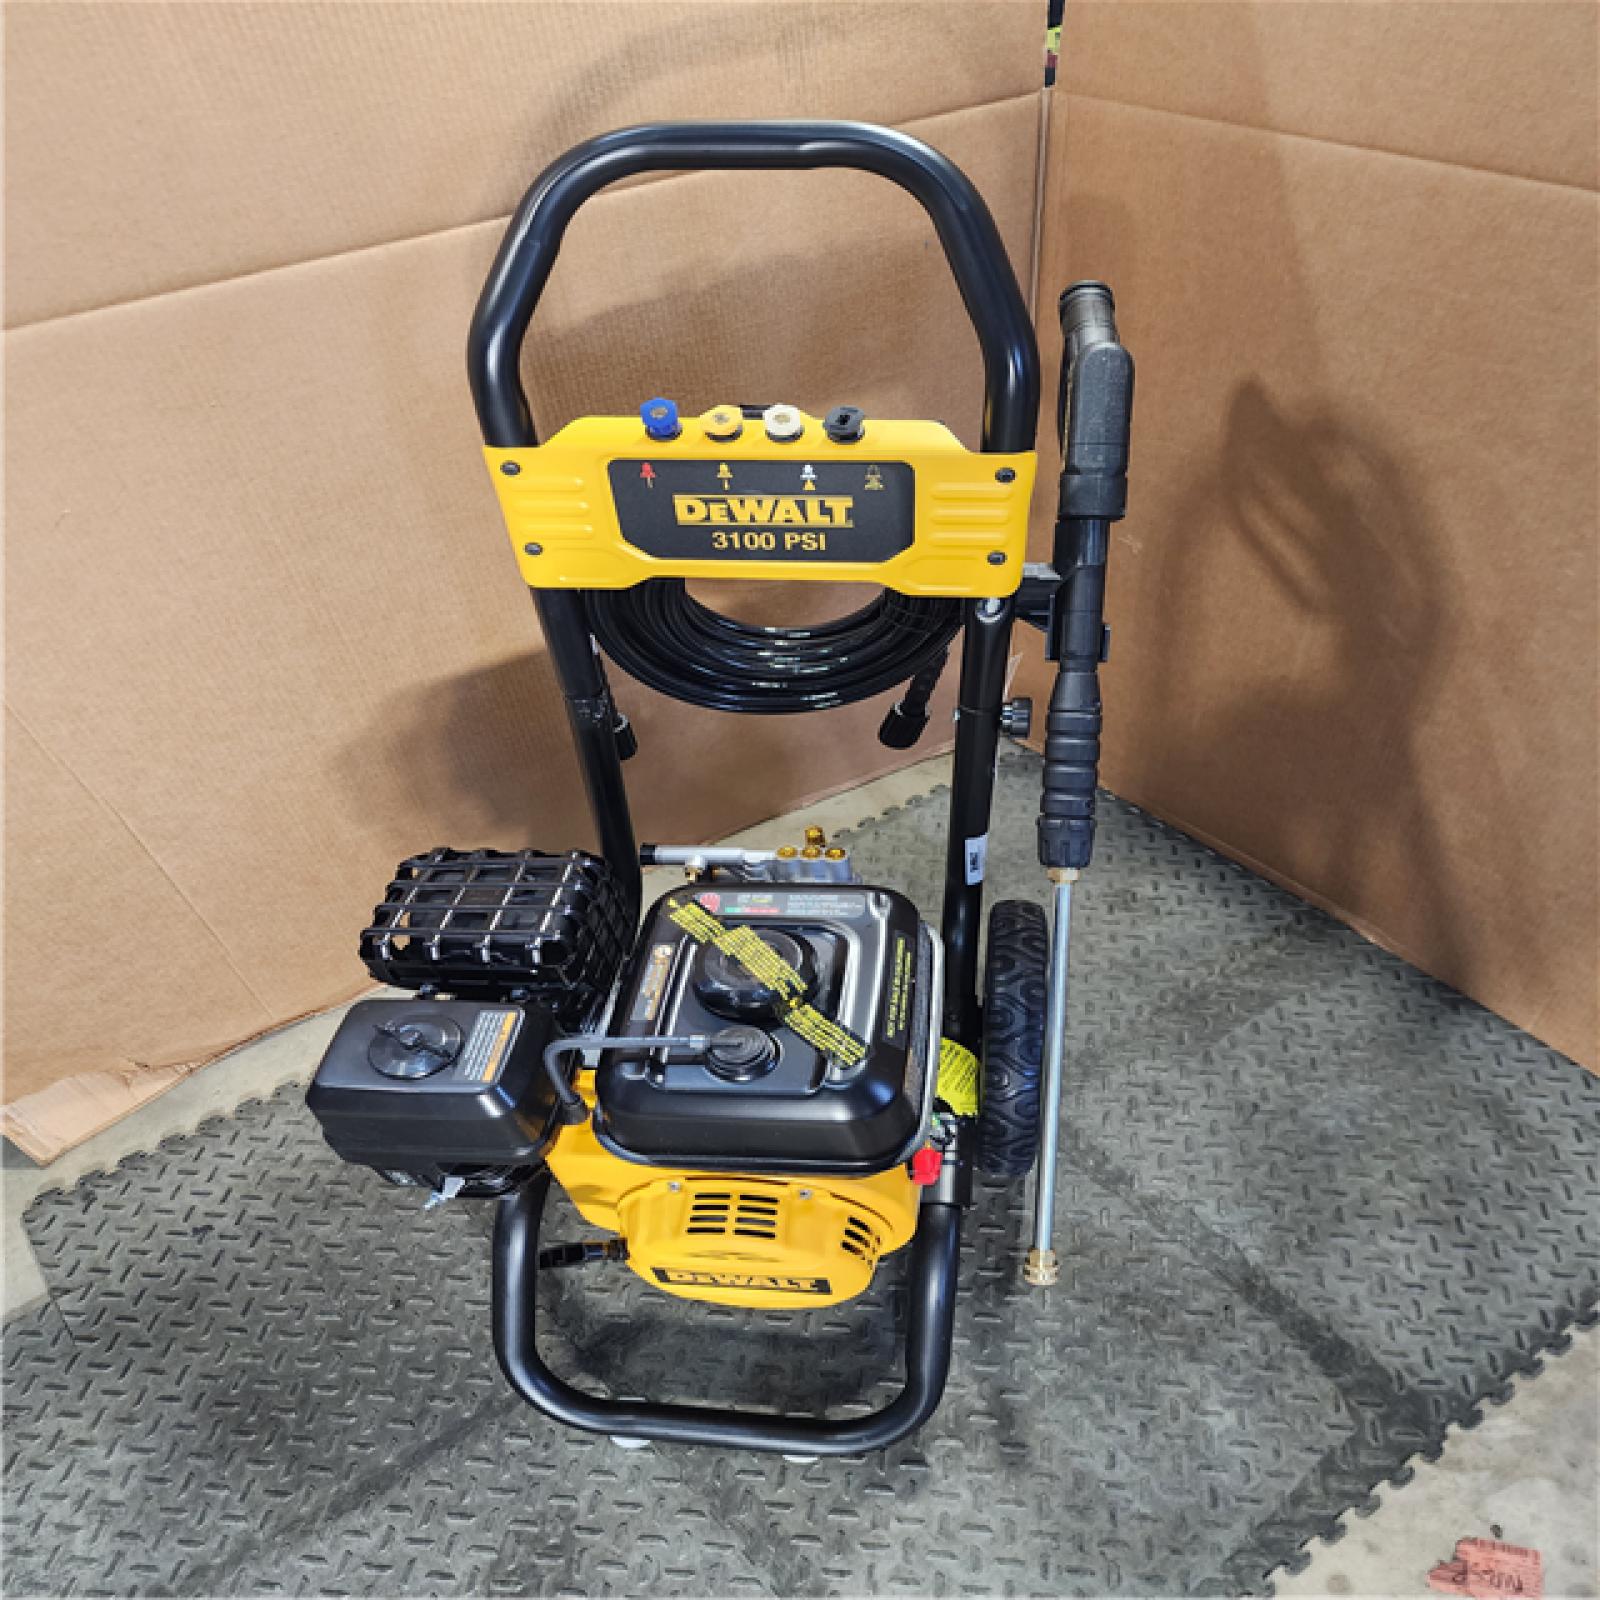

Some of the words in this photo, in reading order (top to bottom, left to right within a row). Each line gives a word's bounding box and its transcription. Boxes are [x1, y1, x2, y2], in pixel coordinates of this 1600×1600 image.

[674, 495, 853, 528] DEWALT
[711, 531, 776, 551] 3100
[784, 531, 826, 552] PSI
